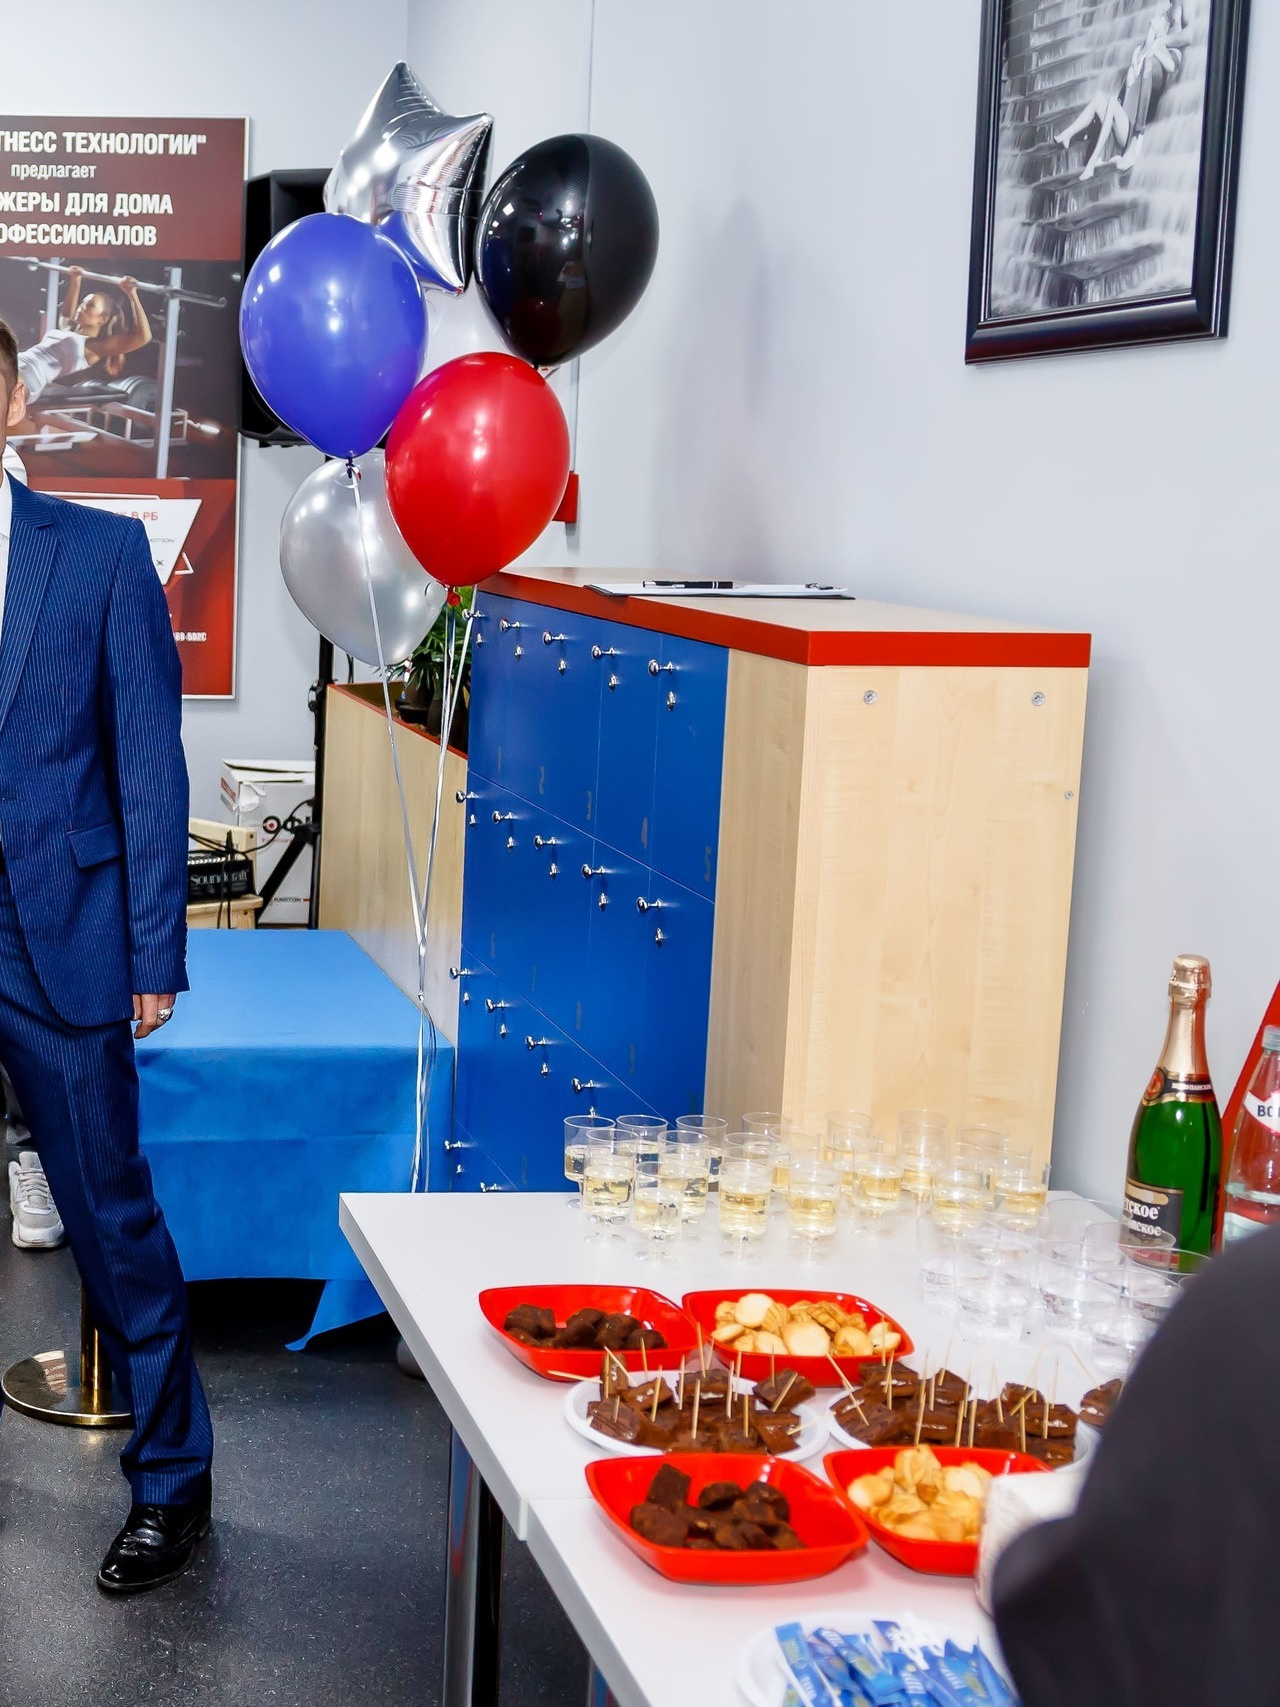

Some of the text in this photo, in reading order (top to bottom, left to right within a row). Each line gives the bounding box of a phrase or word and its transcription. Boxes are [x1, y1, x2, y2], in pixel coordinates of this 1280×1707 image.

[62, 131, 207, 155] ТЕХНОЛОГИИ"
[11, 163, 97, 180] предлагает
[65, 193, 108, 216] ДЛЯ
[113, 194, 173, 216] ДОМА
[143, 511, 159, 521] РБ
